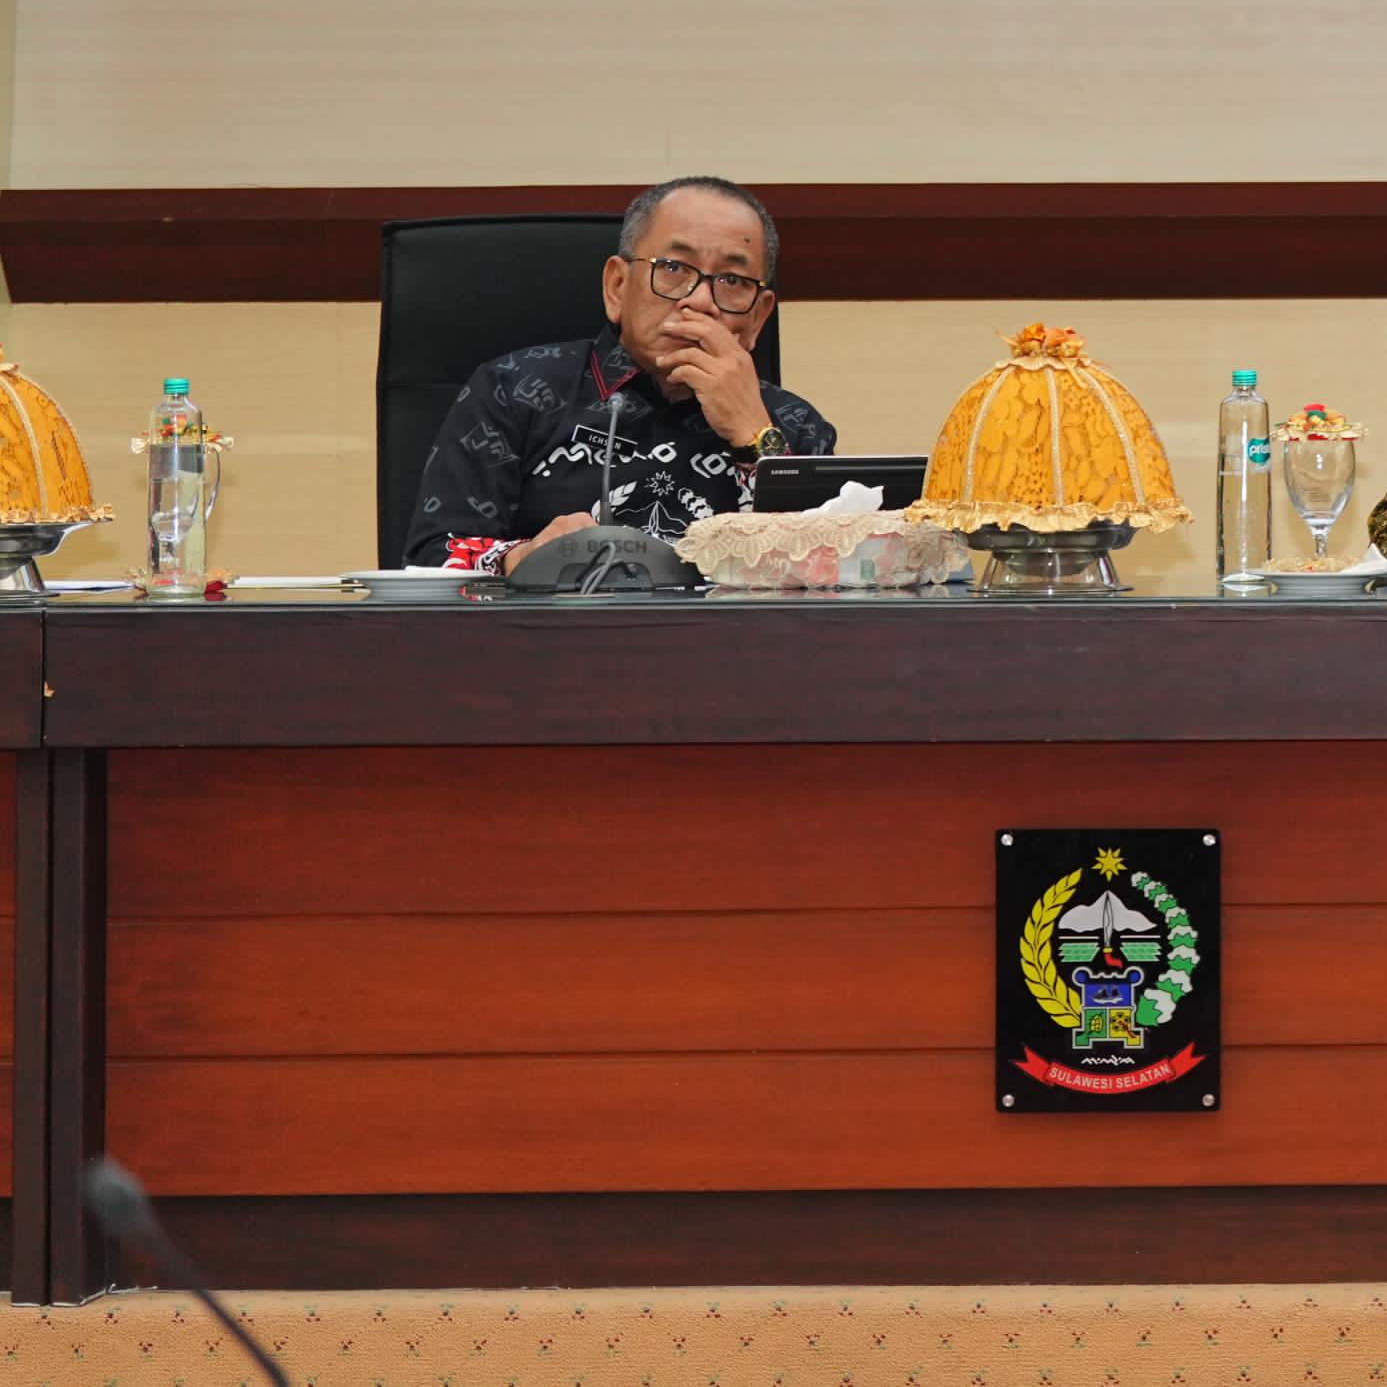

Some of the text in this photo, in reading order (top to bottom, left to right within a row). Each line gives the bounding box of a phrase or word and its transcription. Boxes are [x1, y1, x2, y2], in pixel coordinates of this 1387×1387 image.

[588, 434, 622, 450] ICHSN
[1048, 1063, 1171, 1090] SULAWESI SELATAN
